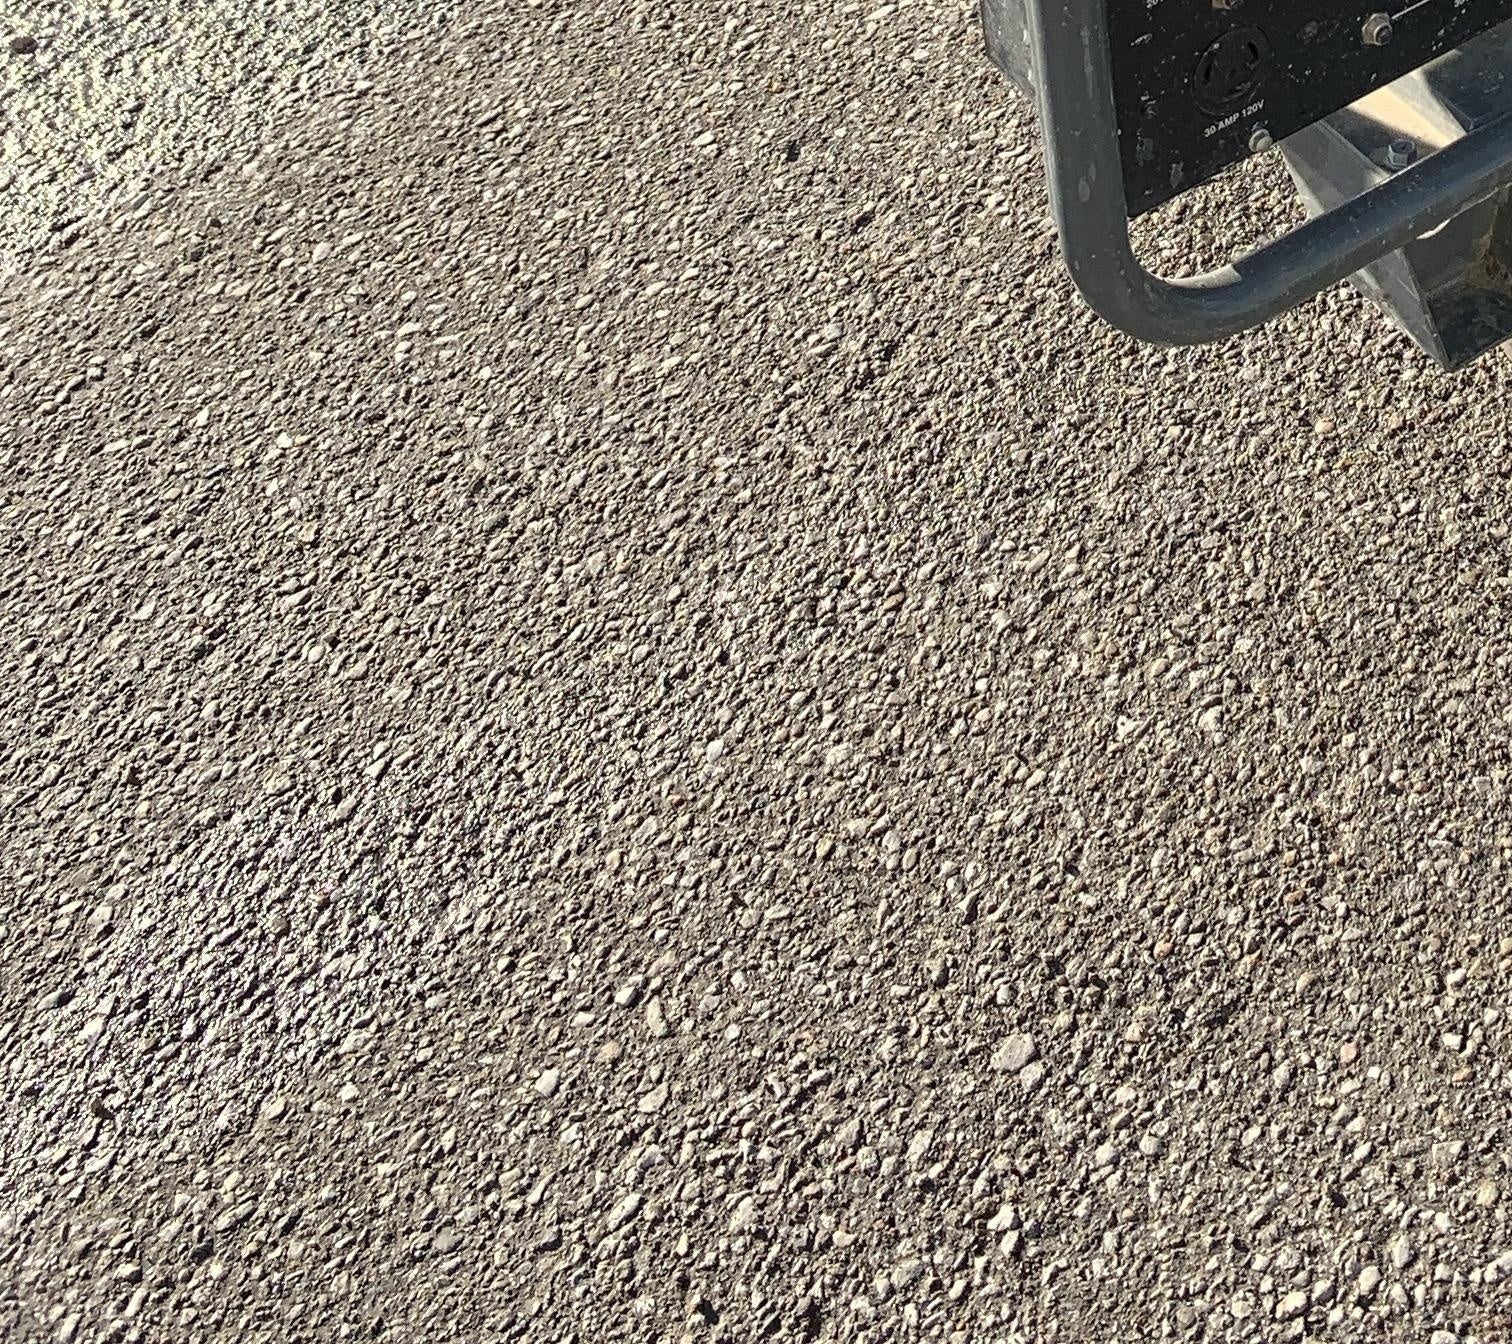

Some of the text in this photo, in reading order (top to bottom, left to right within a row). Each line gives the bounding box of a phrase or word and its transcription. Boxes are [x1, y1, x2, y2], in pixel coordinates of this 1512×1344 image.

[1204, 98, 1265, 138] 30 AMP 120V
